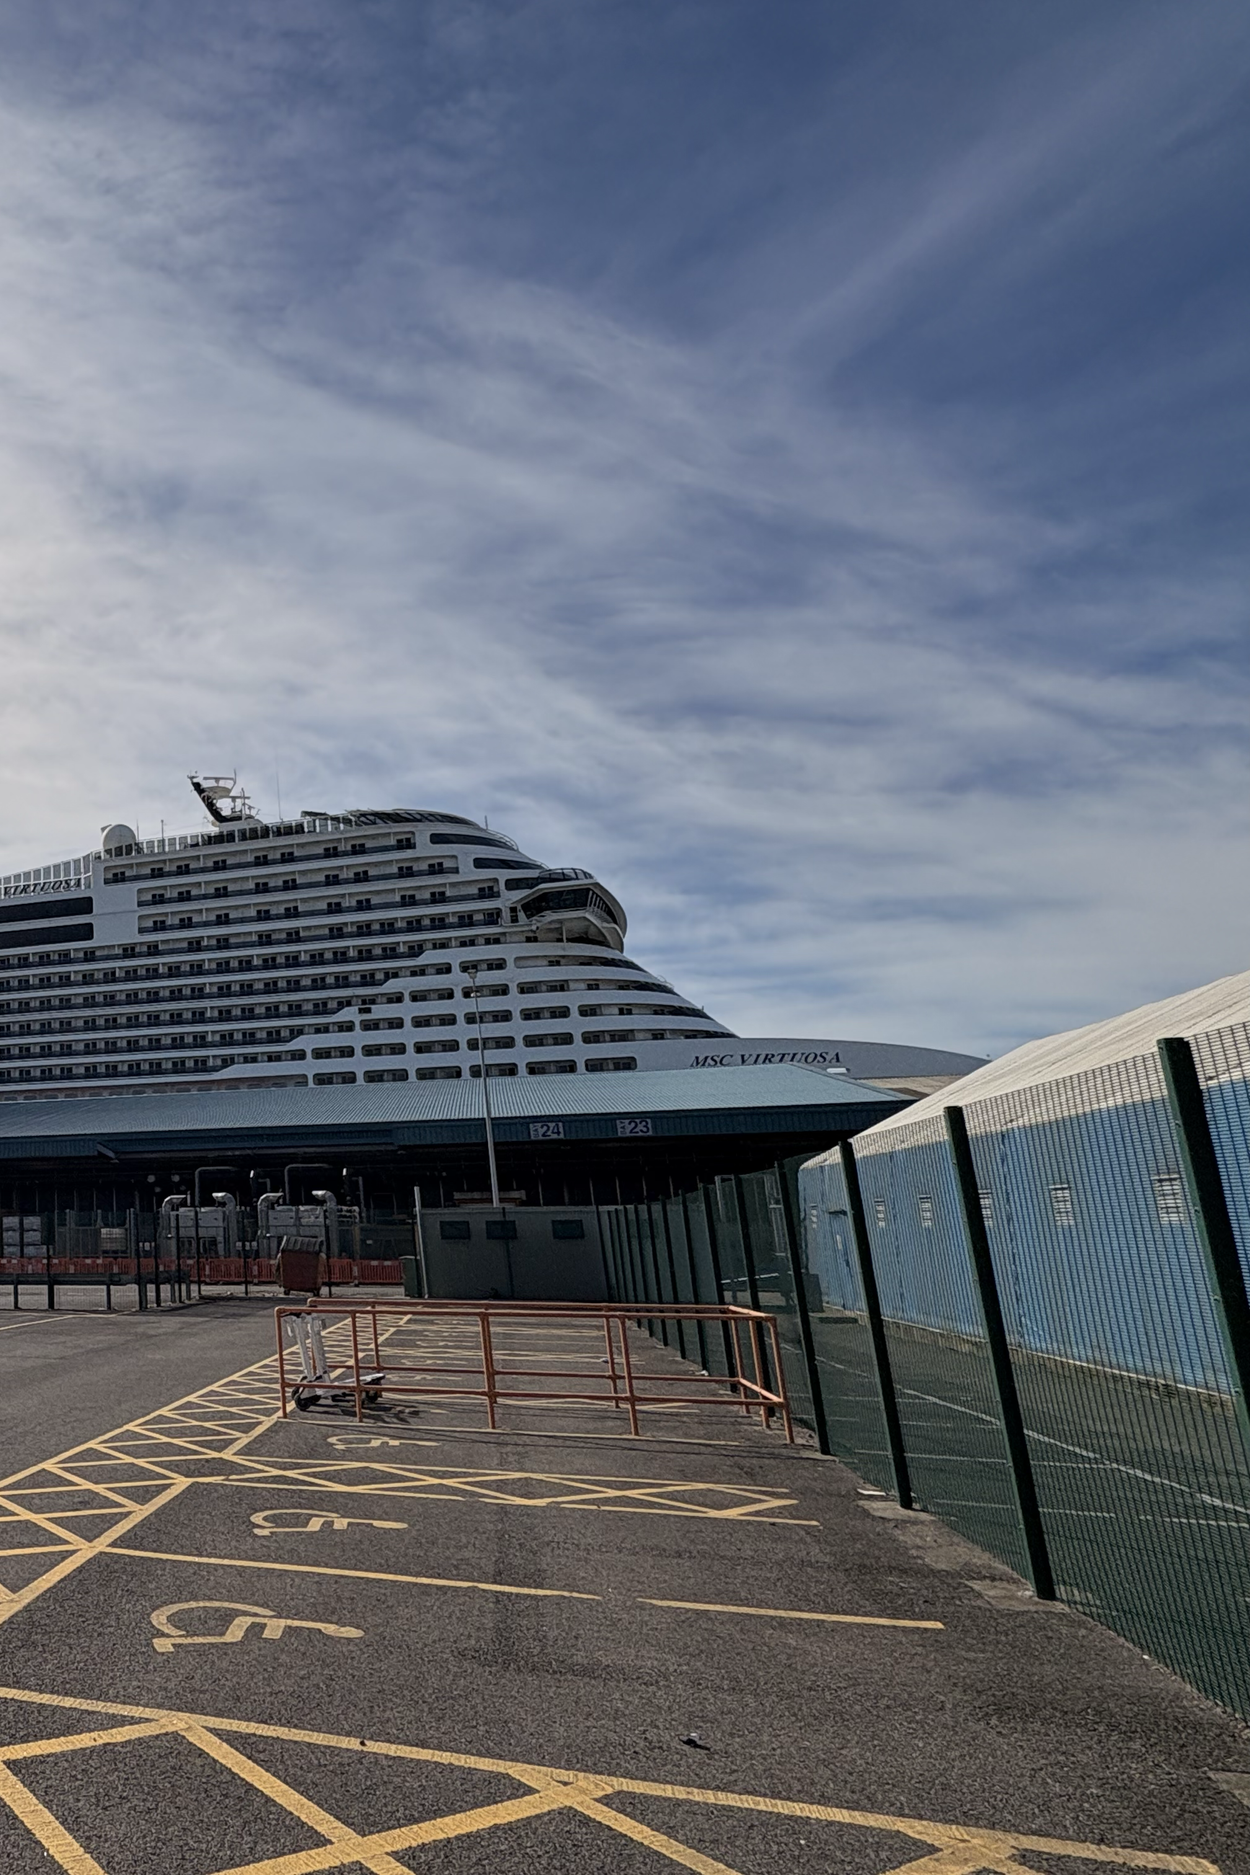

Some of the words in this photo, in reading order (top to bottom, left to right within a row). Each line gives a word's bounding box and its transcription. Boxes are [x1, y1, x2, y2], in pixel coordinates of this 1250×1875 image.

[690, 1054, 733, 1067] MSC
[740, 1052, 842, 1065] VIRTUOSA
[540, 1123, 562, 1137] 24
[619, 1120, 627, 1135] BAY
[628, 1119, 650, 1135] 23
